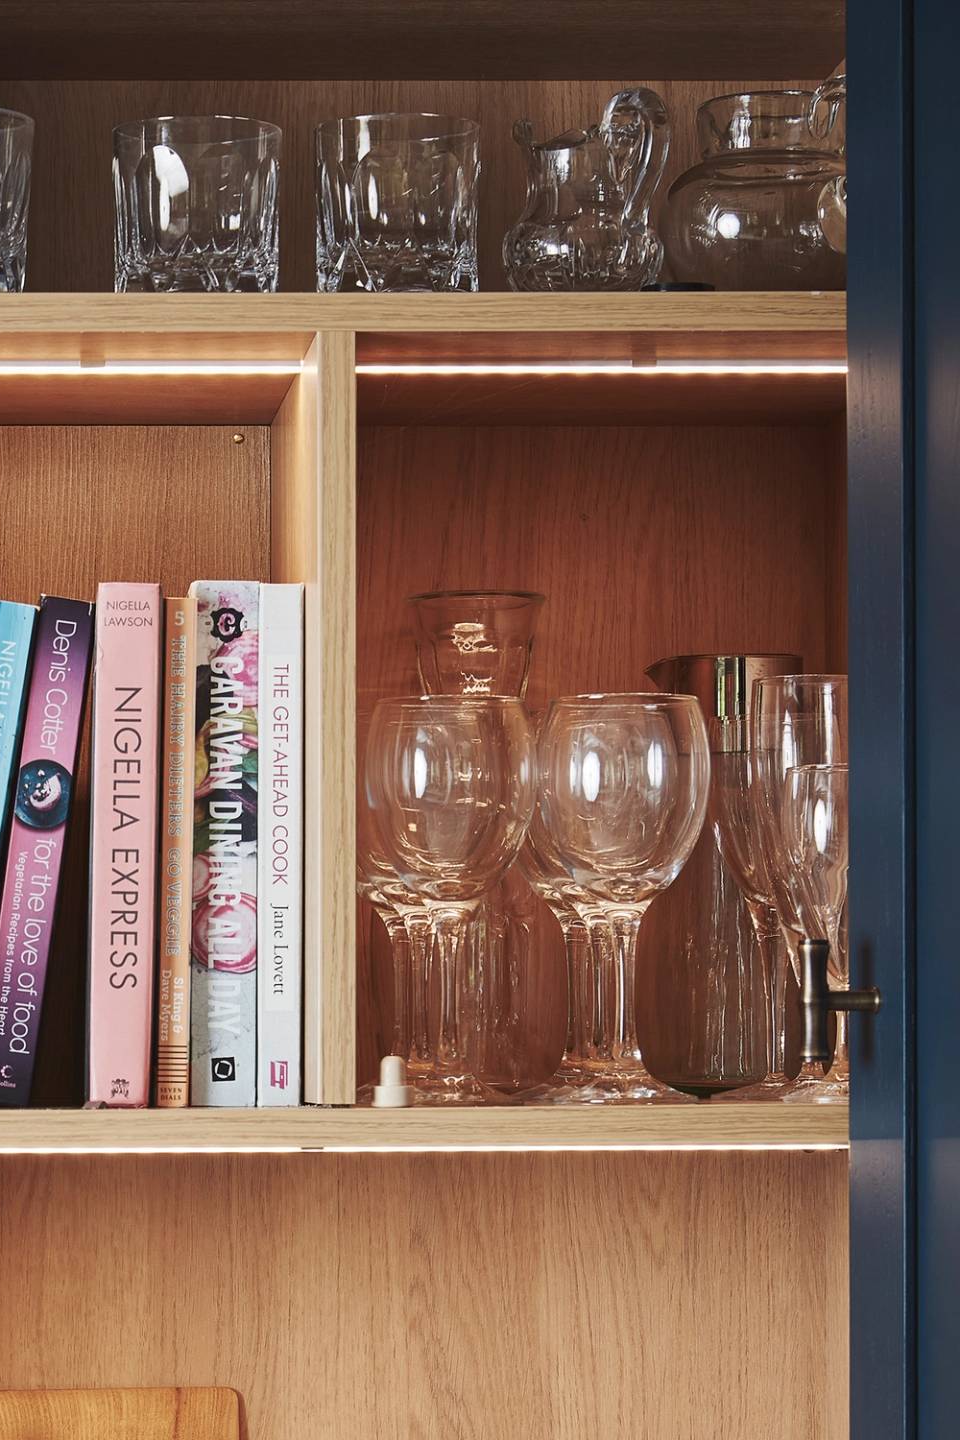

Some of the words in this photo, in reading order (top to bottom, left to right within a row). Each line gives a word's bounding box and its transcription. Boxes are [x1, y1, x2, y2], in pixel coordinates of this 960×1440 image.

[104, 617, 153, 627] LAWSON
[106, 601, 151, 611] NIGELLA
[49, 619, 77, 682] Denis
[170, 635, 187, 677] THE
[273, 663, 289, 699] THE
[40, 689, 67, 754] Cotter
[170, 683, 186, 746] HAIRY
[209, 656, 244, 790] CARAVAN
[112, 687, 143, 832] NIGELLA
[272, 705, 289, 818] GET-AHEAD
[168, 751, 185, 836] DIETERS
[33, 838, 56, 869] for
[167, 848, 182, 878] GO
[208, 801, 242, 906] DINING
[272, 825, 289, 885] COOK
[11, 852, 28, 911] Vegetarian
[27, 873, 52, 912] the
[6, 912, 20, 956] Recipes
[20, 919, 46, 966] love
[109, 848, 139, 989] EXPRESS
[165, 881, 181, 956] VEGGIE
[270, 903, 289, 939] Jane
[208, 917, 242, 969] ALL
[2, 956, 15, 984] from
[17, 972, 37, 996] of
[162, 970, 172, 1001] Dave
[273, 945, 289, 995] Lovett
[0, 986, 9, 1003] the
[171, 993, 184, 1025] King
[208, 980, 241, 1035] DAY
[9, 1001, 36, 1054] food
[160, 1004, 170, 1041] Myers
